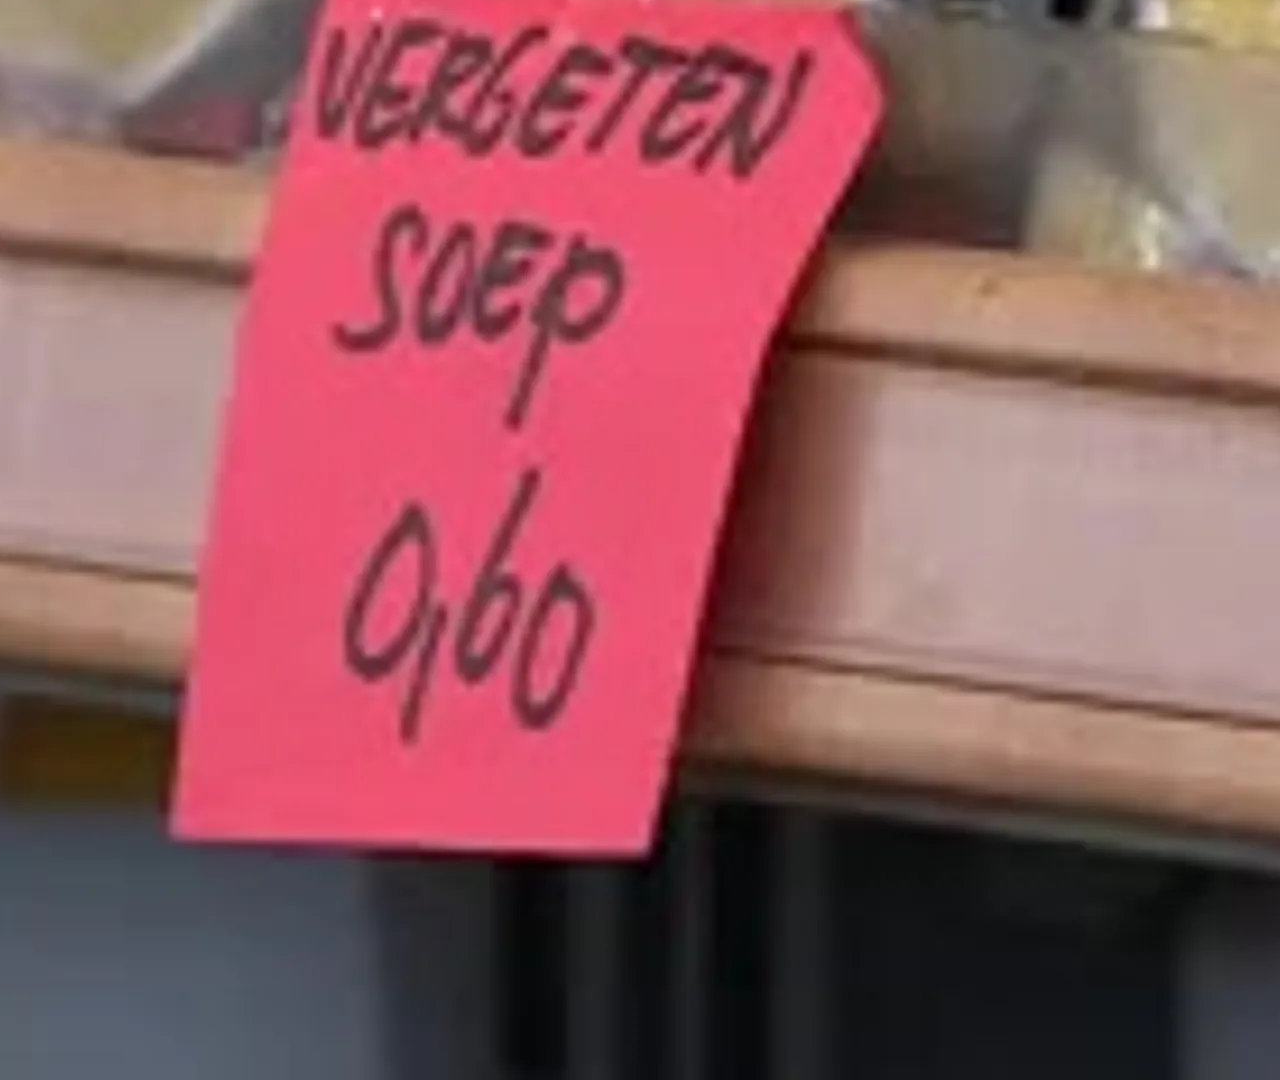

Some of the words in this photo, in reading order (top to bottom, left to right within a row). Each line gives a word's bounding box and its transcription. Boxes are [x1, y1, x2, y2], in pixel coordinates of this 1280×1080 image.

[315, 18, 815, 180] VERGETEN
[332, 202, 626, 432] SOEP
[342, 465, 596, 746] 0,60
